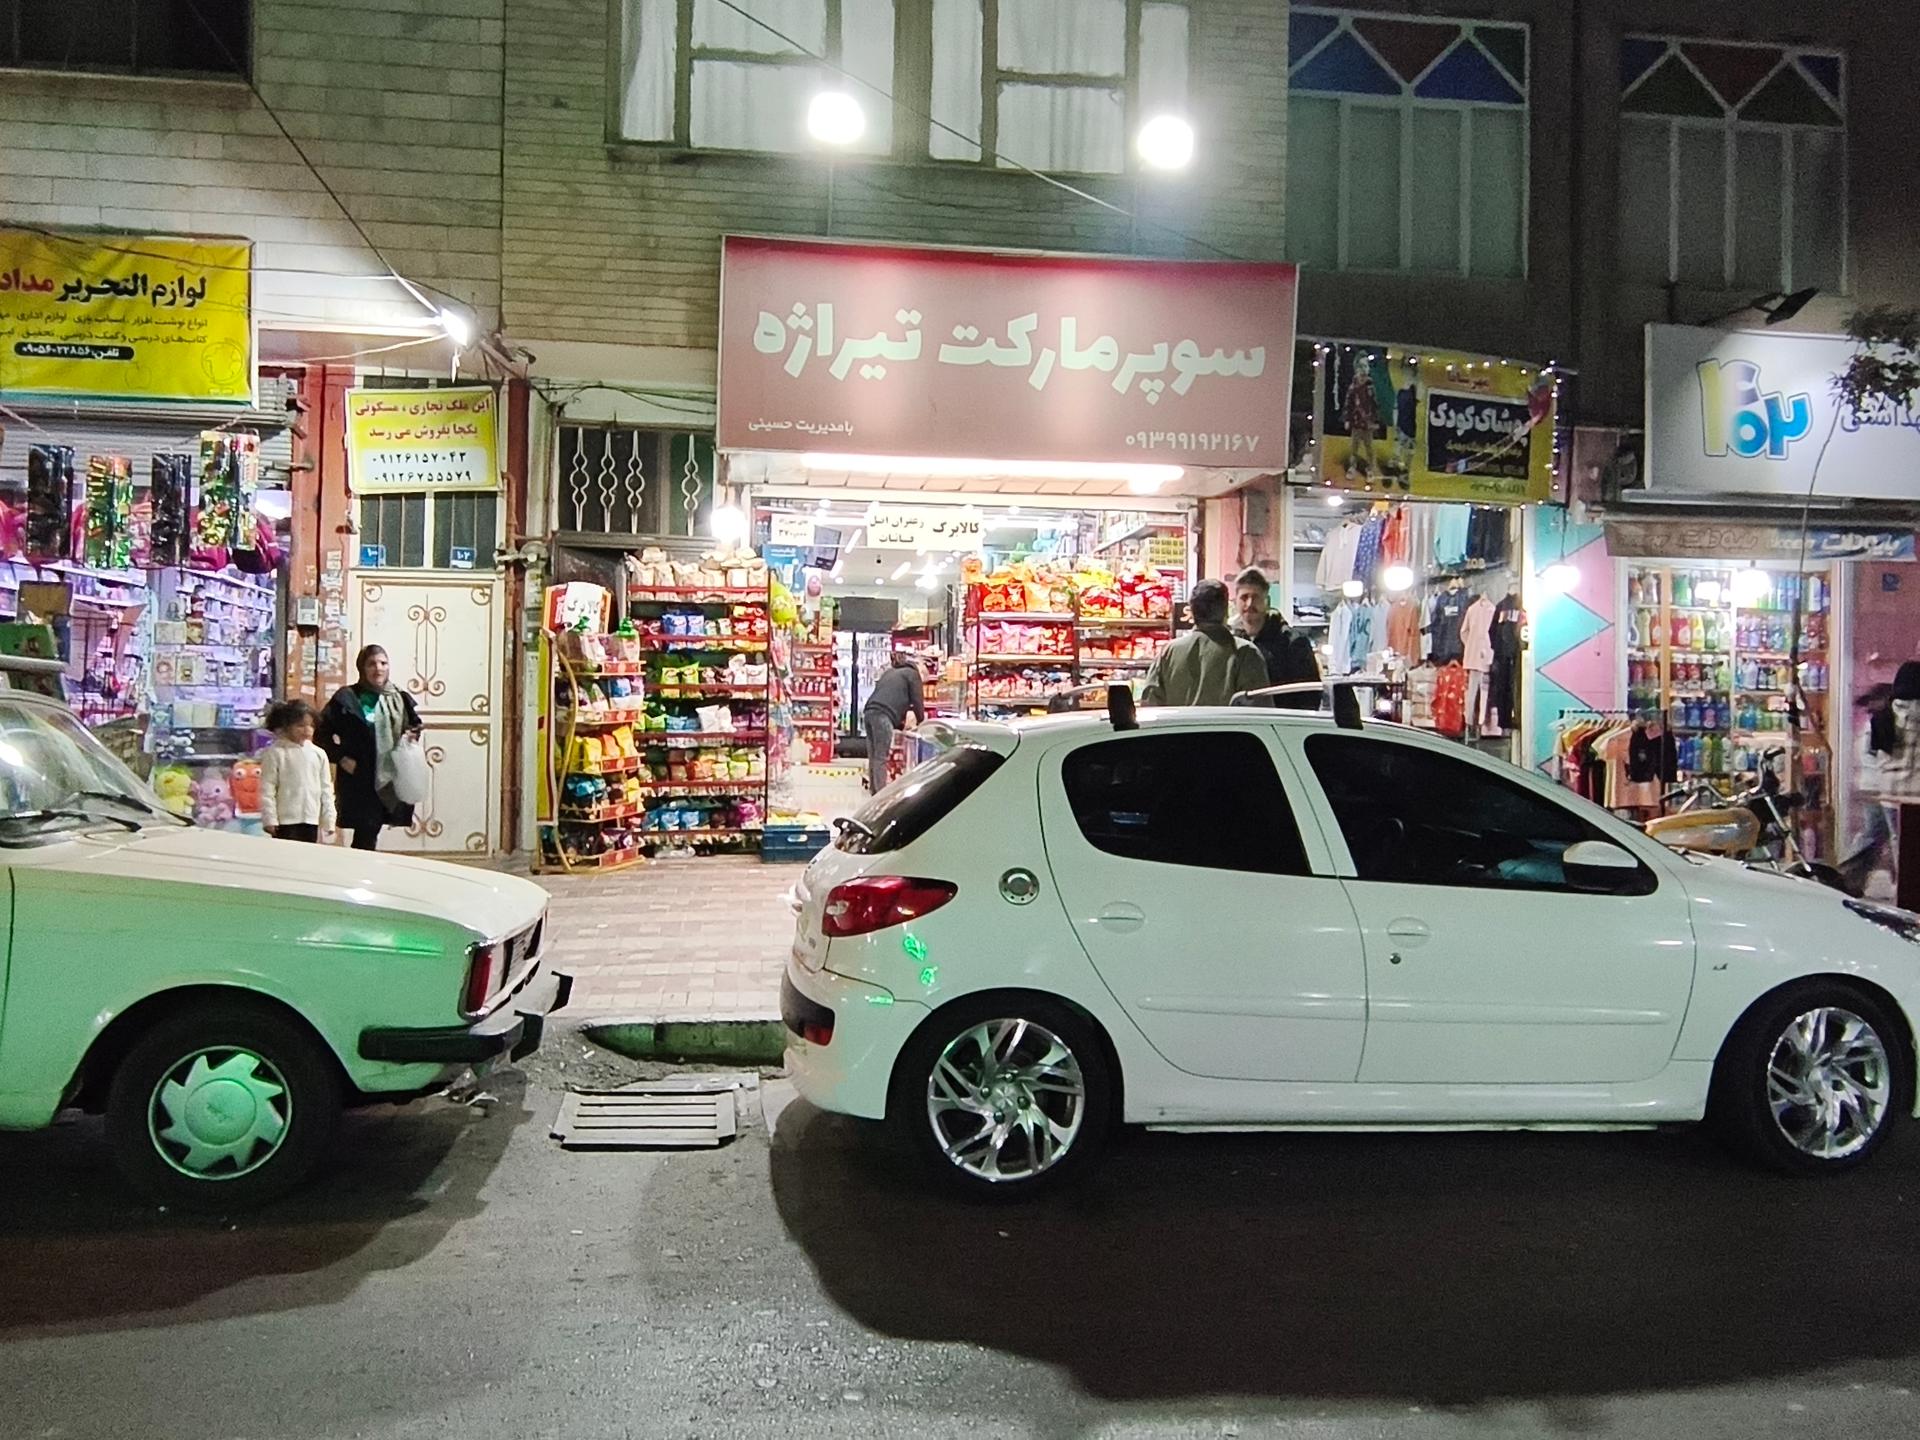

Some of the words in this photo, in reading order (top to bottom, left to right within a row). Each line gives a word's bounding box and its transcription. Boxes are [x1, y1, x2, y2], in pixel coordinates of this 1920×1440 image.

[56, 273, 148, 303] التحریر
[152, 276, 206, 307] لوازم
[752, 301, 923, 381] تیراژه
[355, 400, 399, 416] مسکونی
[446, 400, 469, 411] ملک
[471, 399, 489, 413] این
[748, 417, 793, 431] حسینی
[1429, 402, 1475, 437] کودک
[394, 429, 411, 439] می
[414, 425, 450, 439] بفروش
[1125, 431, 1260, 452] ۰۹۳۹۹۱۹۲۱۶۷
[374, 470, 471, 482] ۰۹۱۲۶۷۵۵۵۷۹
